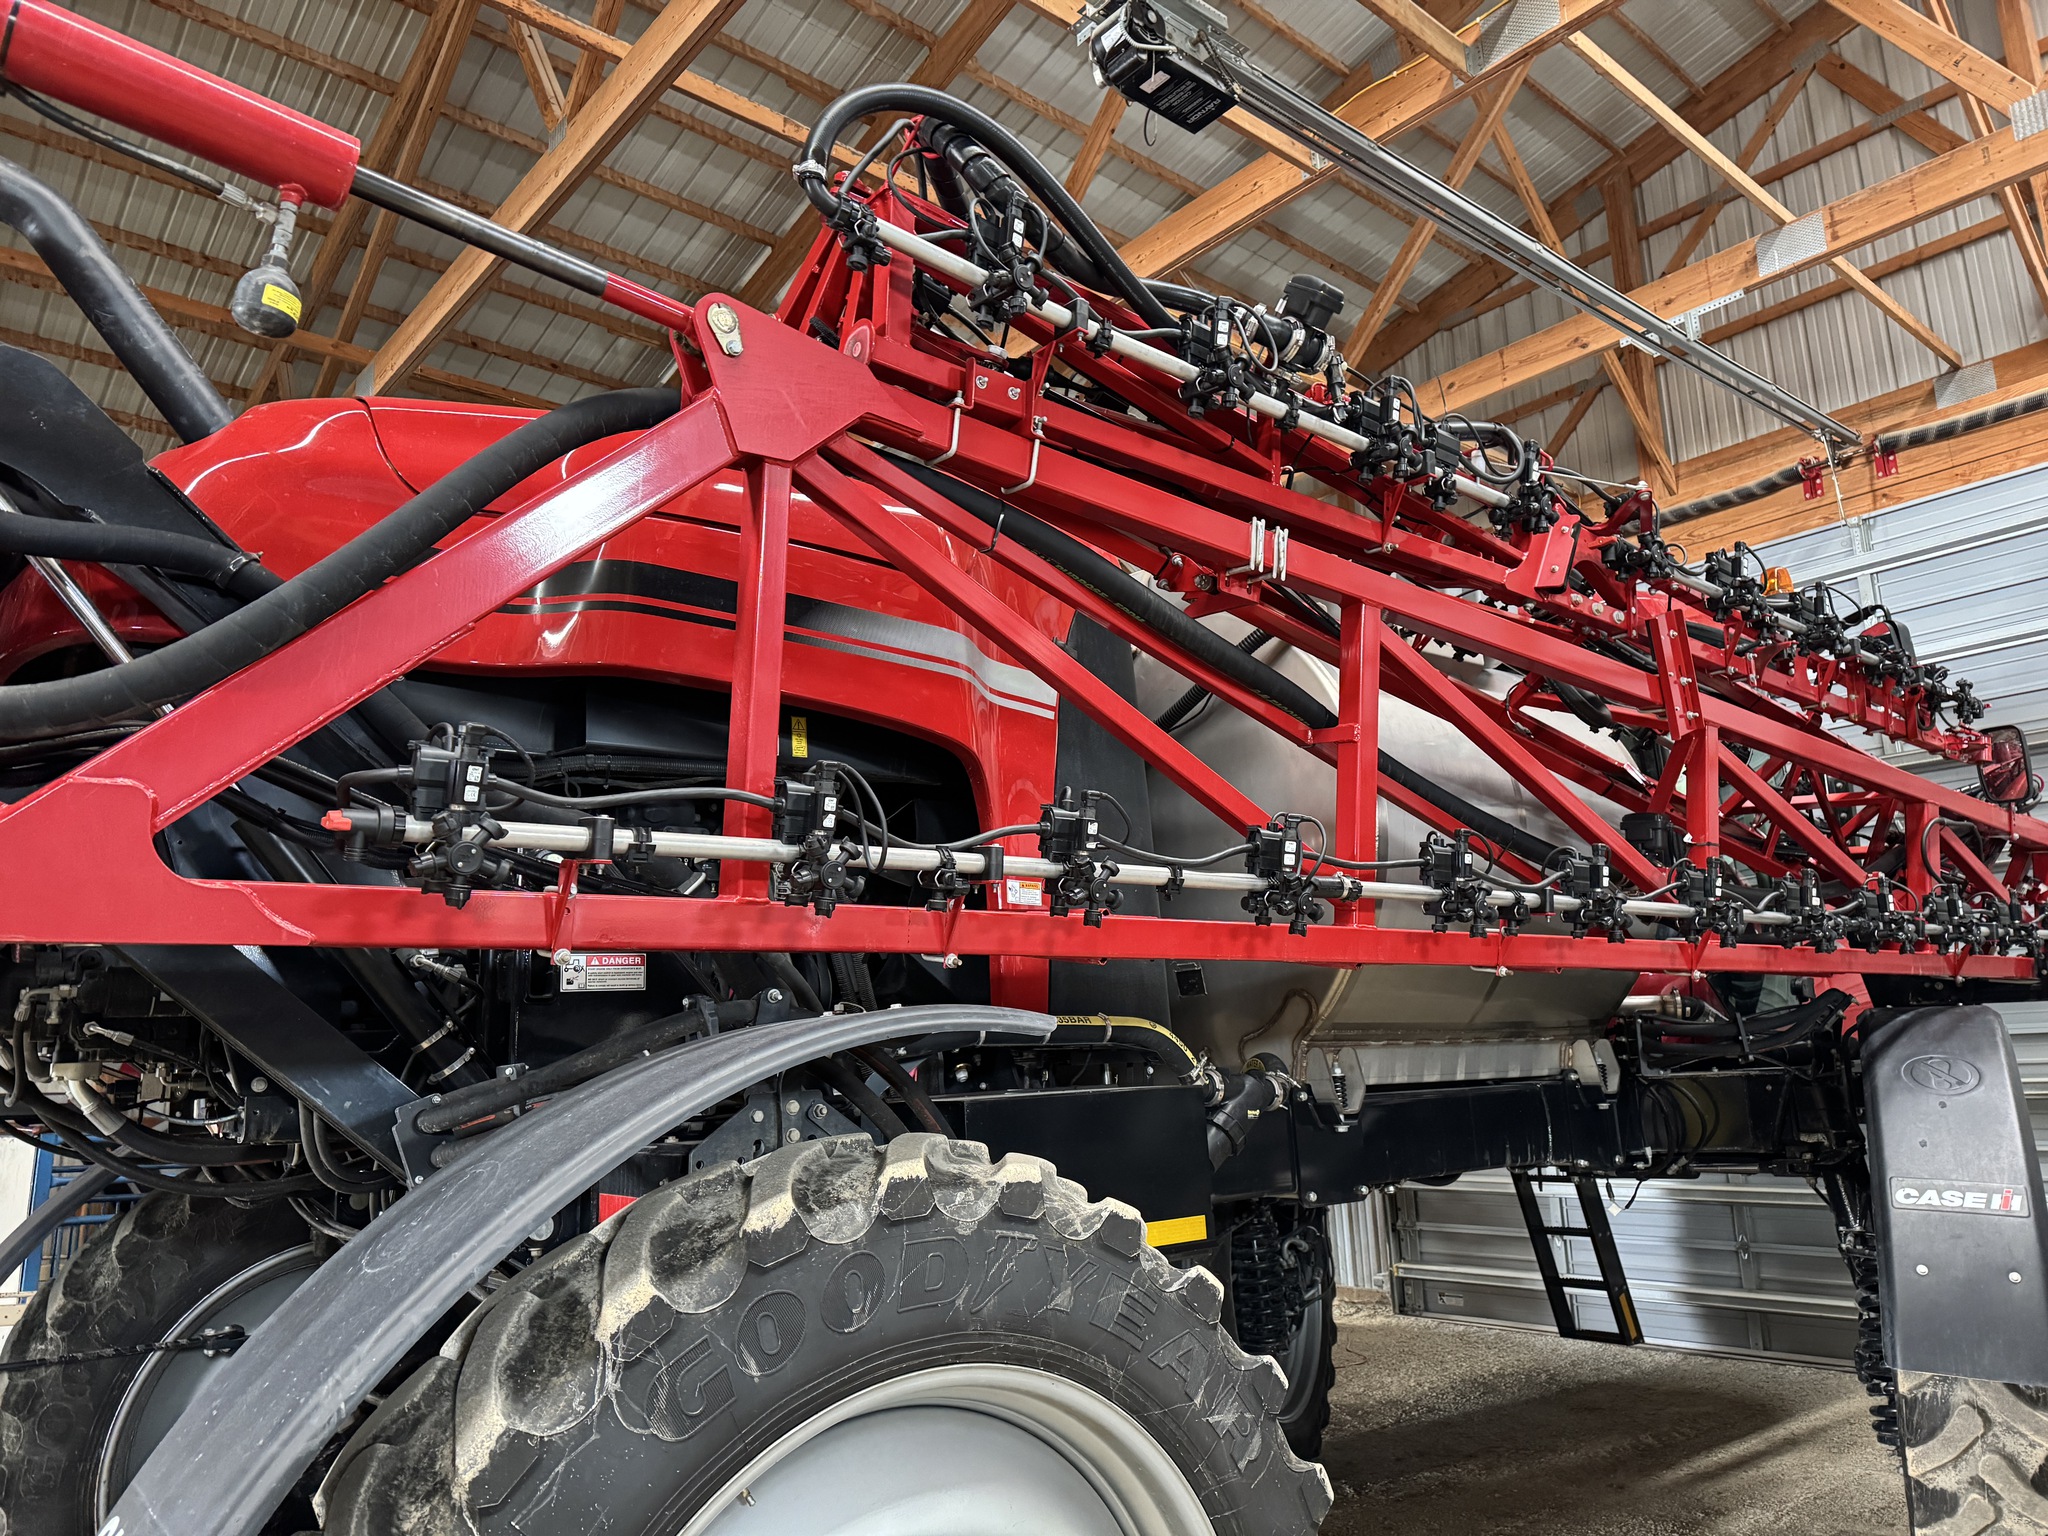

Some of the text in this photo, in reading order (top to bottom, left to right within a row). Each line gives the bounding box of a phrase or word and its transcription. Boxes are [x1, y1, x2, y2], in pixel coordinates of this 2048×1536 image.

[1186, 98, 1221, 124] RAYNOR
[602, 957, 641, 965] DANGER
[1895, 1187, 1988, 1209] CASE
[645, 1232, 1262, 1474] GOODYEAR
